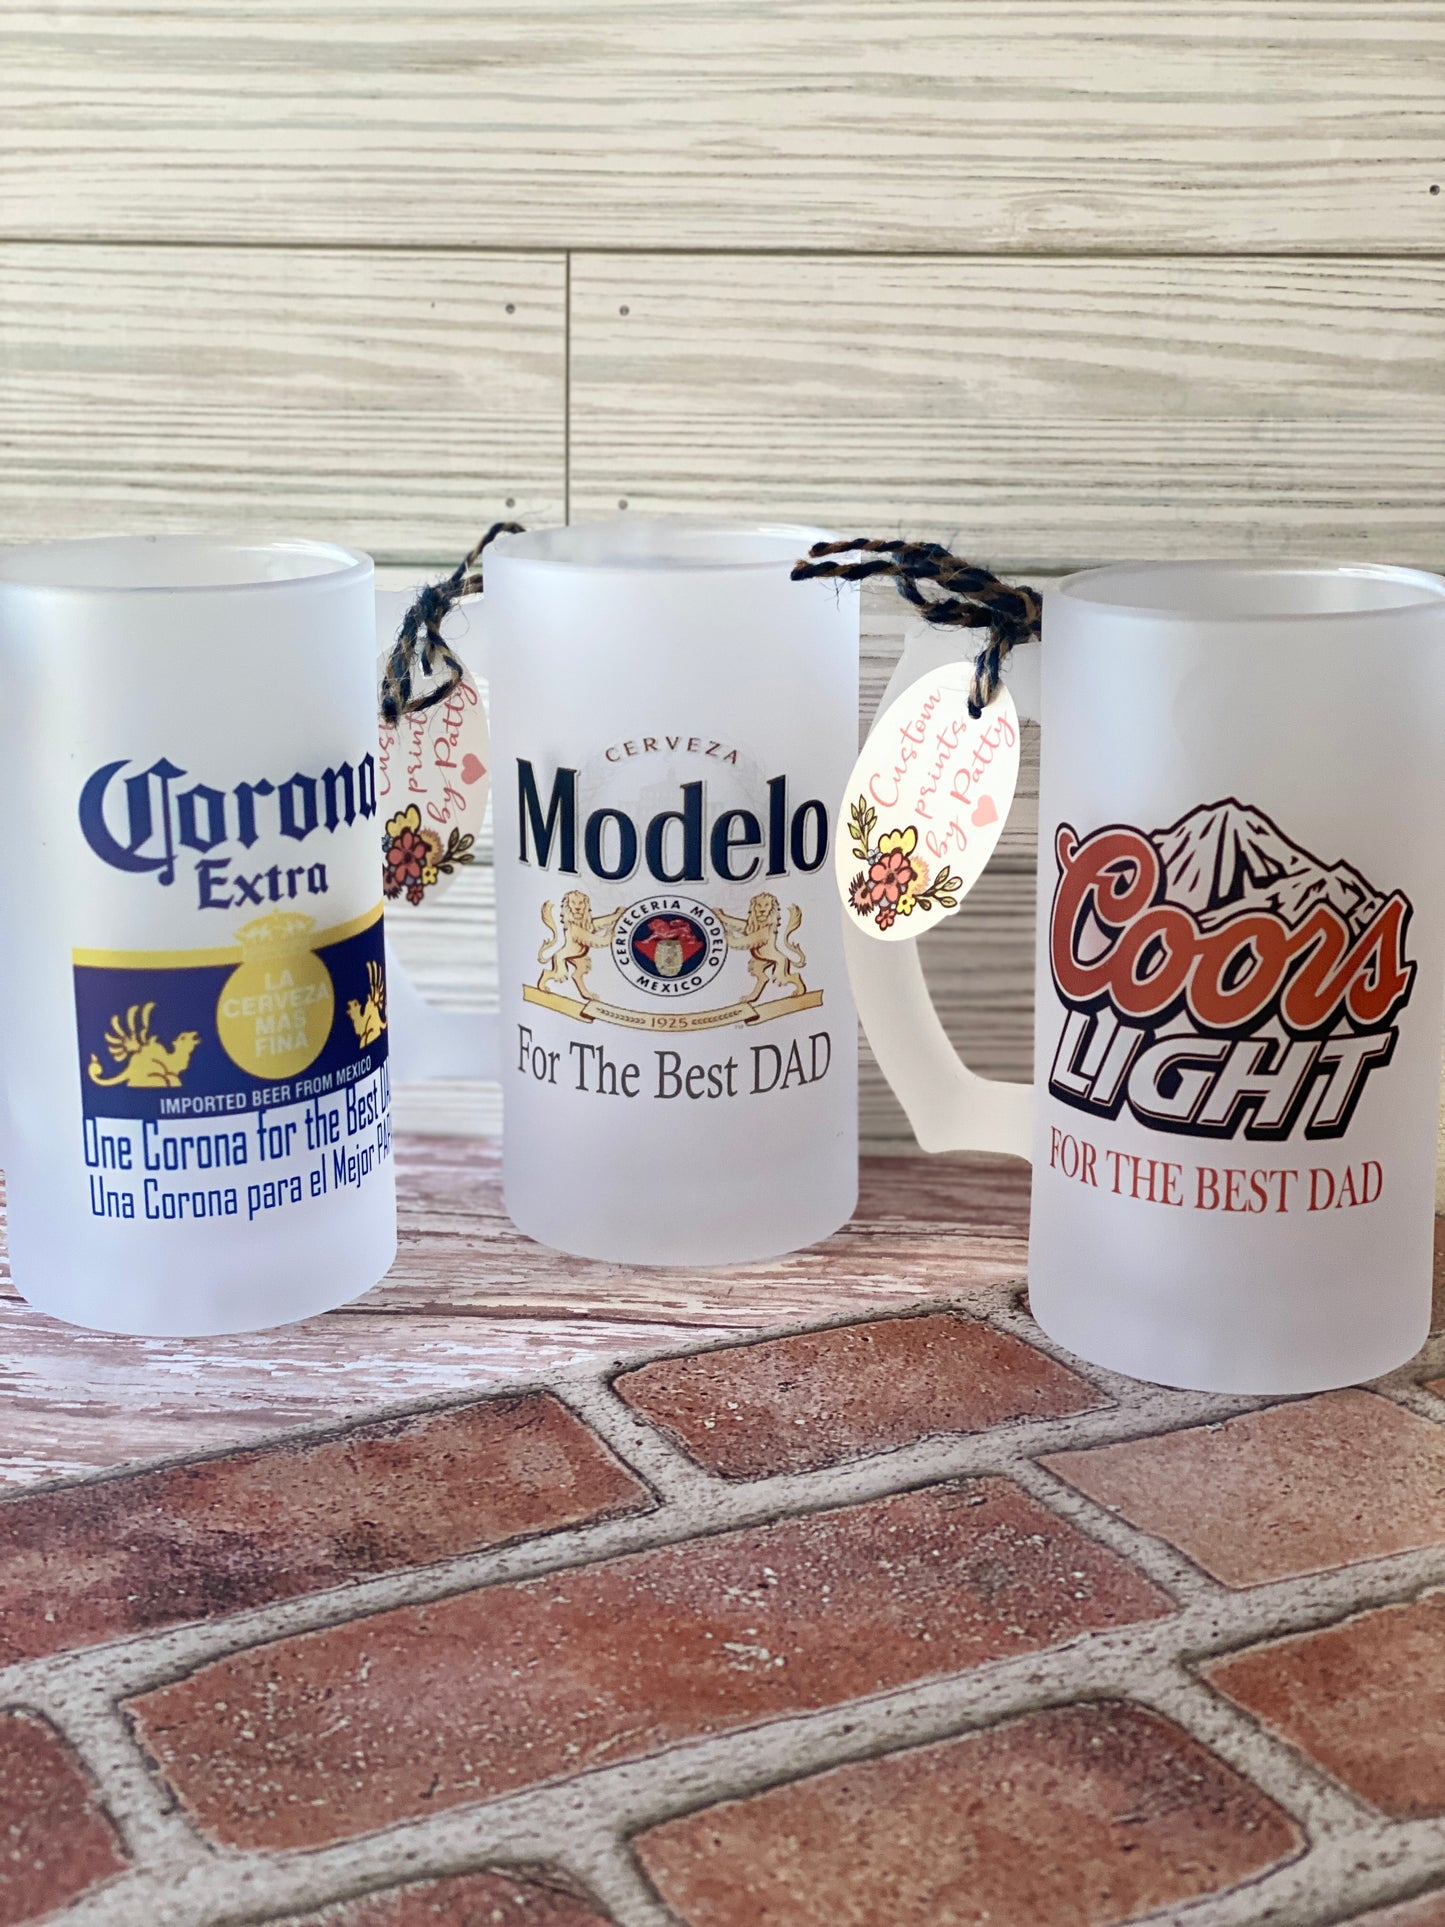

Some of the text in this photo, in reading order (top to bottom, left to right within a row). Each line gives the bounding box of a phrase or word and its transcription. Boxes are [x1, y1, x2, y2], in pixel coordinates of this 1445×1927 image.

[405, 711, 428, 793] print
[604, 736, 738, 765] CERVEZA
[869, 689, 942, 807] Custom
[914, 716, 967, 819] prints
[926, 709, 1016, 858] by Patty
[78, 752, 377, 886] Corona
[426, 780, 466, 824] by
[516, 757, 831, 883] Modelo
[194, 857, 329, 910] Extra
[615, 900, 724, 967] CERVECERIA MODELO
[1050, 822, 1417, 1037] Coors
[222, 983, 330, 1018] CERVEZA
[264, 969, 294, 992] LA
[636, 976, 703, 993] MEXICO
[255, 1007, 307, 1034] MAS
[255, 1032, 309, 1057] FINA
[651, 1017, 688, 1029] 1925
[160, 1055, 372, 1115] IMPORTED BEER FROM MEXICO
[517, 1024, 832, 1100] For The Best DAD
[1049, 1008, 1399, 1141] LIGHT
[83, 1117, 132, 1169] One
[142, 1117, 248, 1171] Corona
[256, 1108, 297, 1162] for
[304, 1095, 339, 1150] the
[345, 1079, 379, 1137] Best
[89, 1174, 135, 1219] Una
[143, 1178, 238, 1220] Corona
[247, 1175, 302, 1221] para
[310, 1153, 328, 1197] el
[333, 1145, 376, 1189] Mejor
[1050, 1125, 1384, 1214] FOR THE BEST DAD
